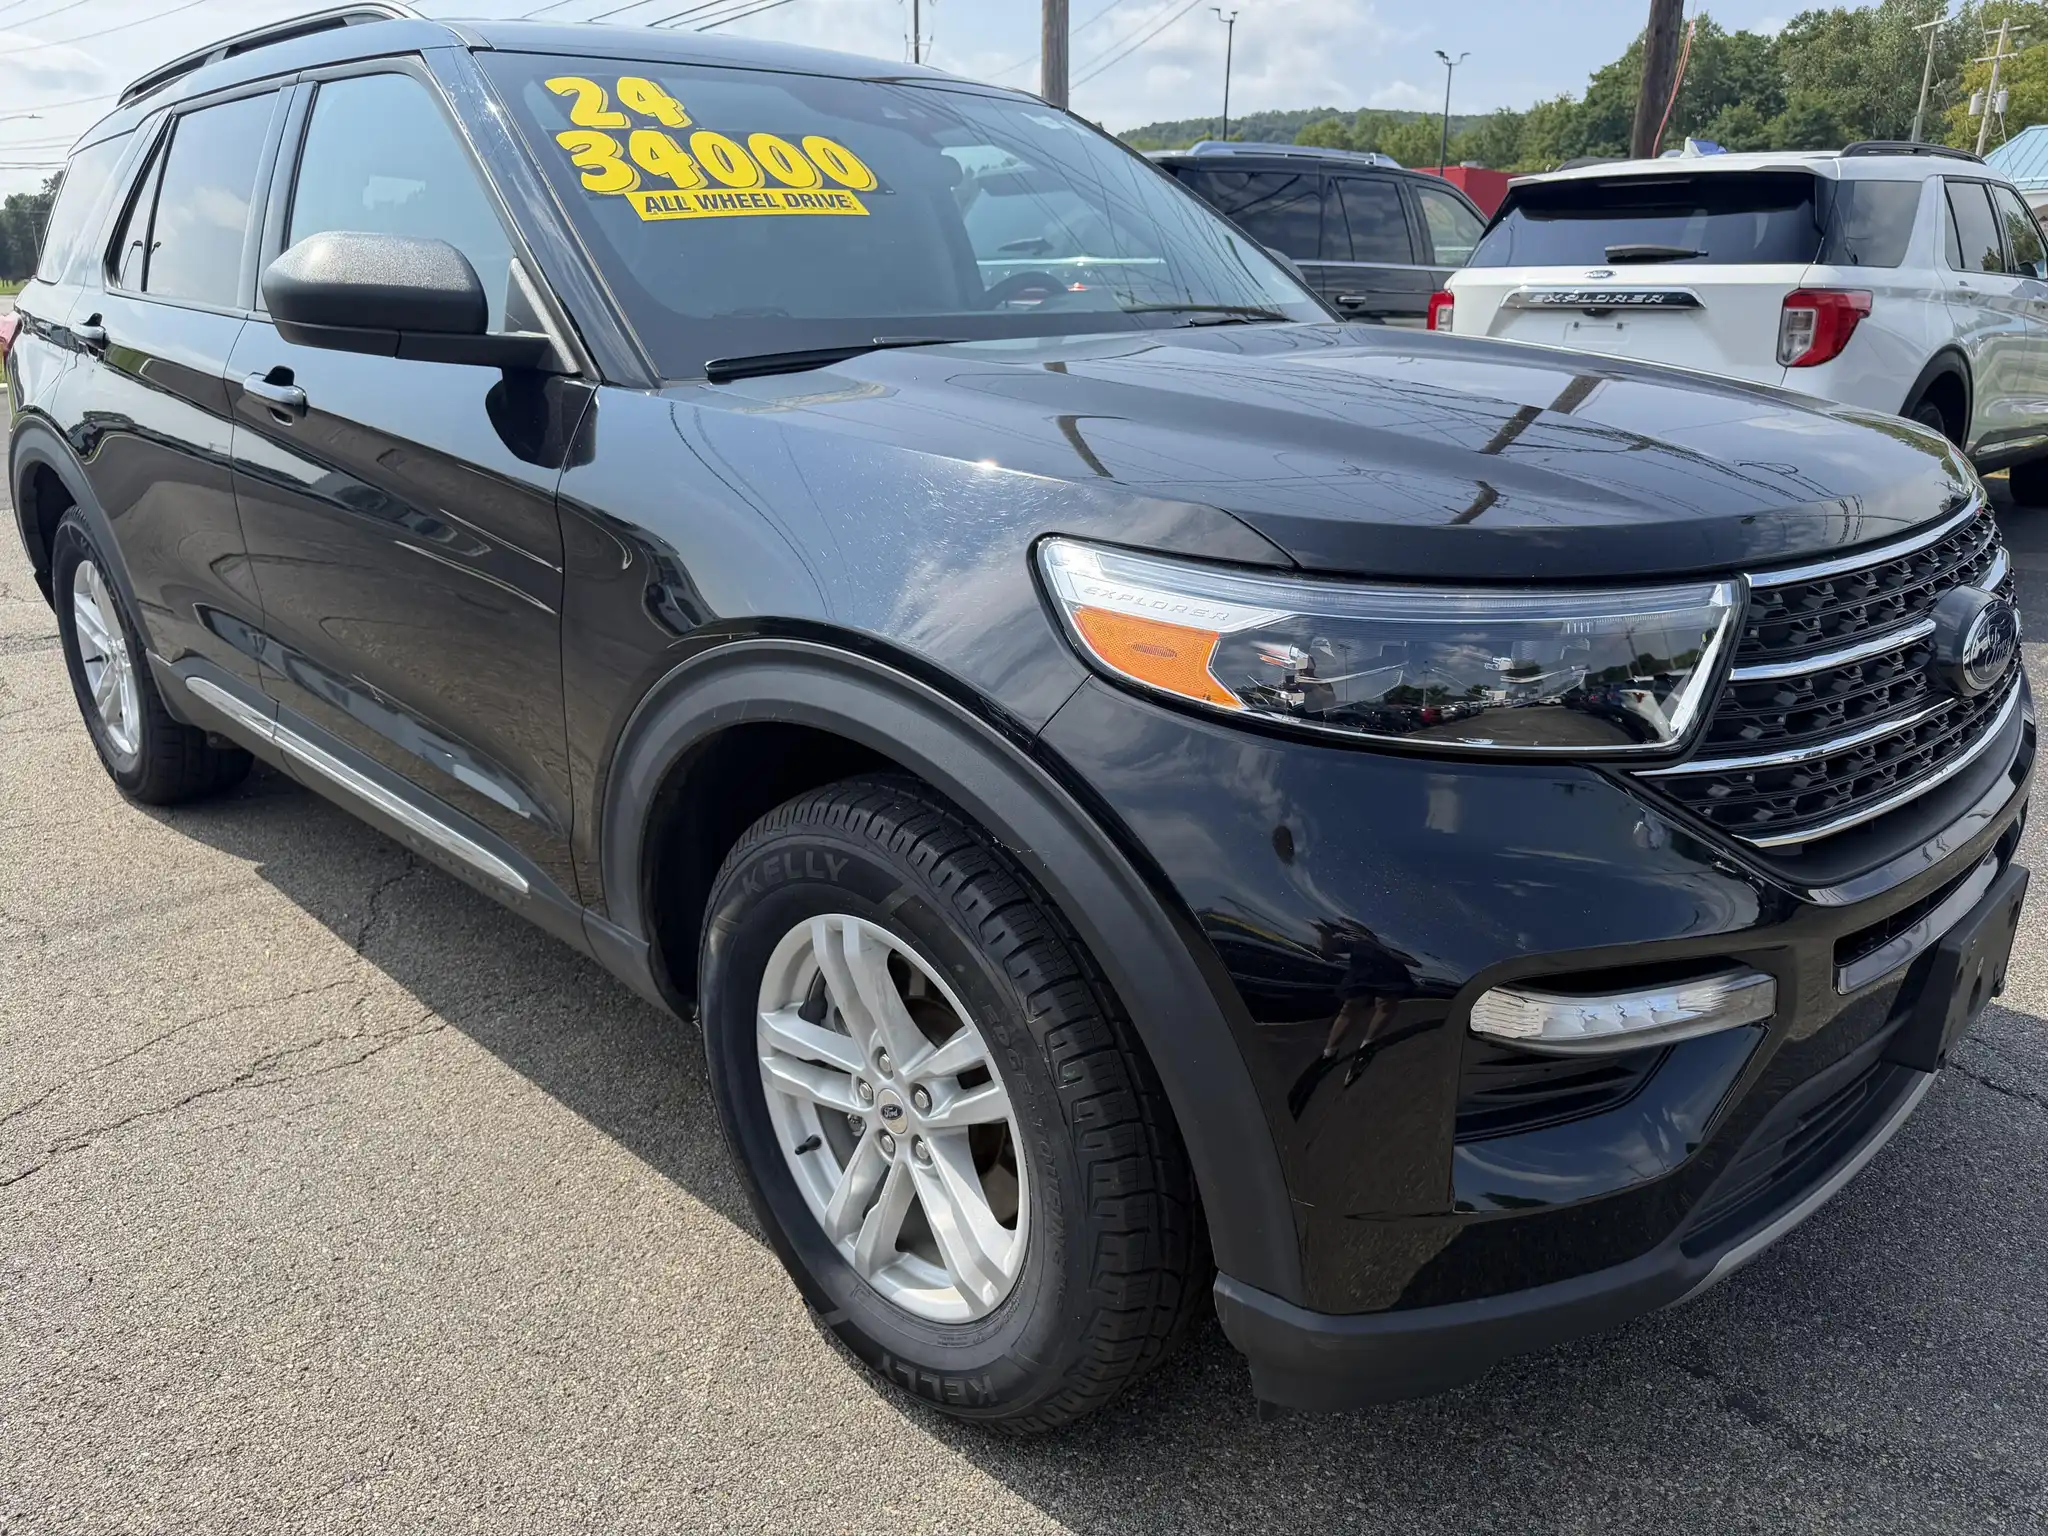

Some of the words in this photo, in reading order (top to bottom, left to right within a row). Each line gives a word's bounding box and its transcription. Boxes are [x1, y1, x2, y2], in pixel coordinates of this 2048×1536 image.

[545, 76, 692, 129] 24
[556, 130, 878, 193] 34000
[645, 195, 692, 214] ALL
[698, 193, 780, 212] WHEEL
[786, 191, 853, 210] DRIVE
[1529, 293, 1665, 304] EXPLORER
[1083, 586, 1230, 622] EXPLORER
[1985, 618, 2012, 673] Ford
[742, 850, 849, 896] KELLY
[981, 1003, 1035, 1097] EDGE
[883, 1106, 899, 1119] Ford
[877, 1353, 998, 1406] KELLY
